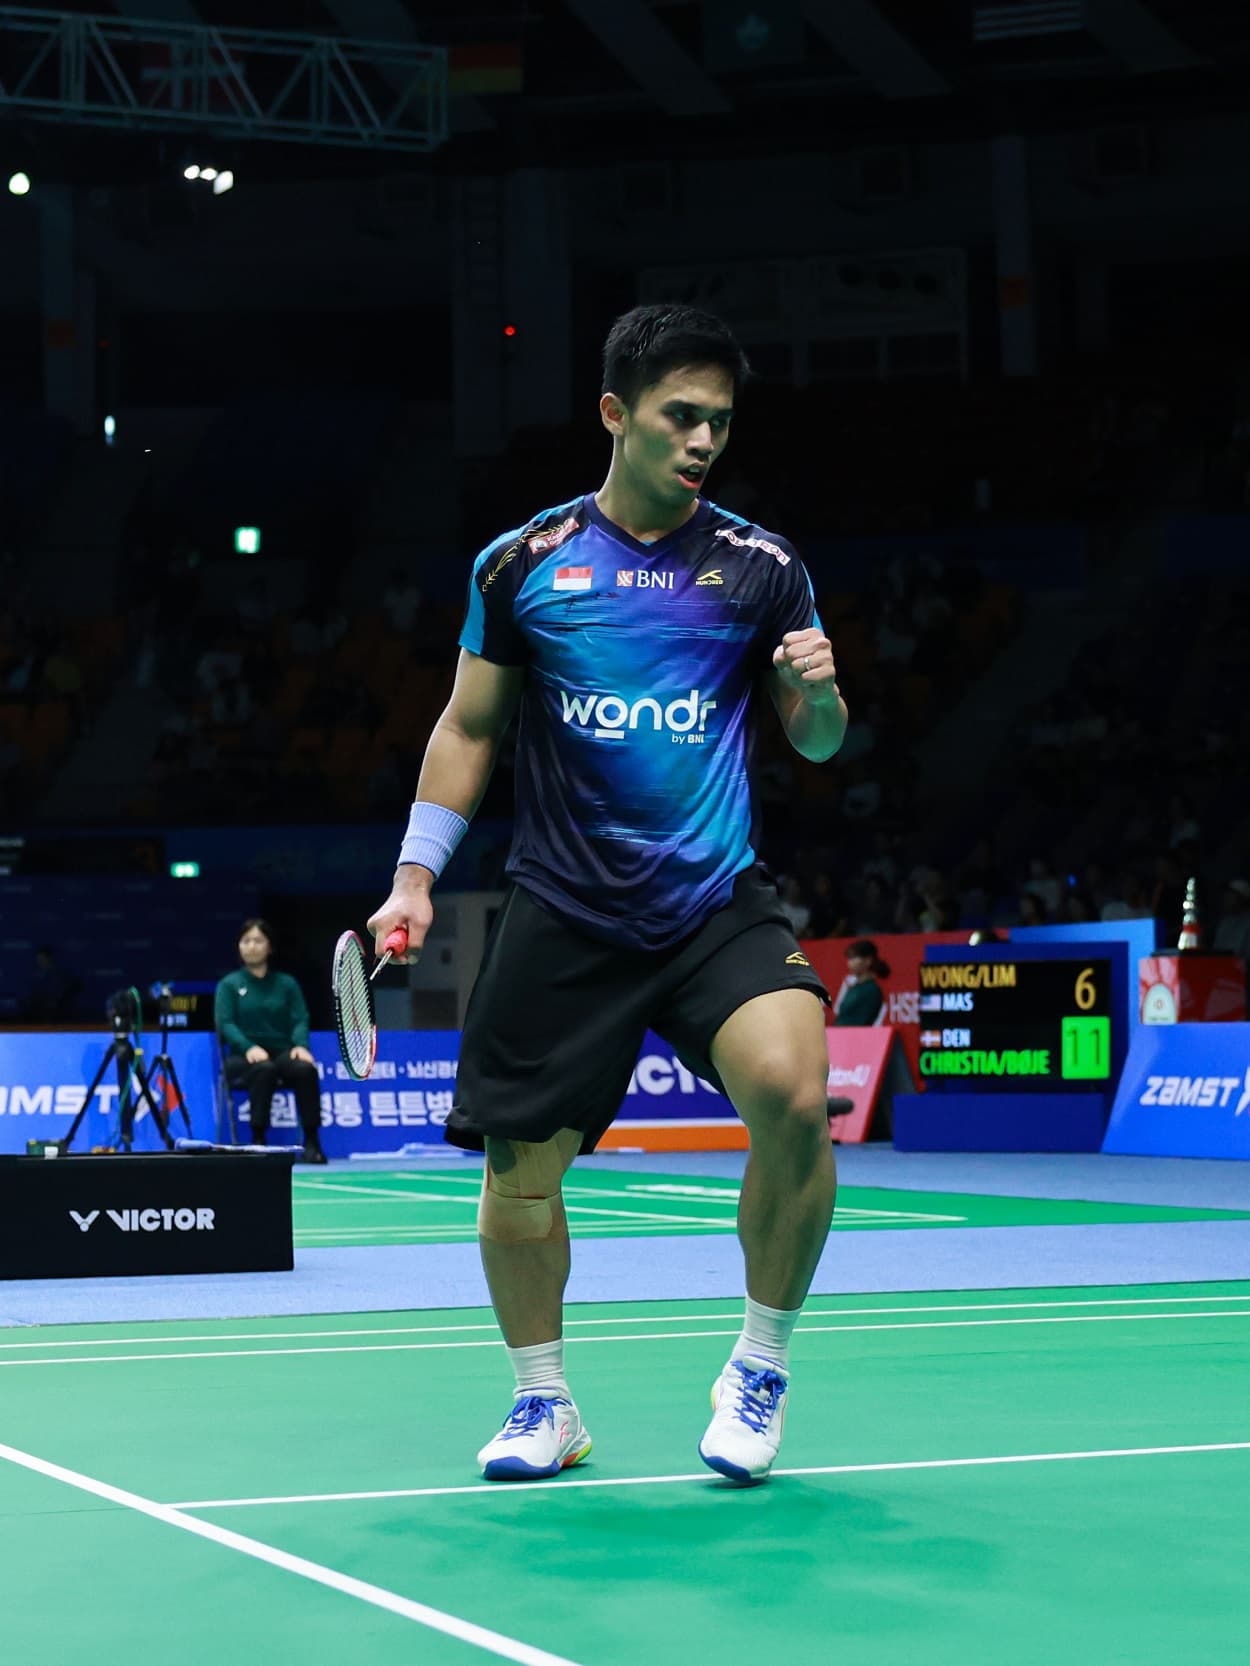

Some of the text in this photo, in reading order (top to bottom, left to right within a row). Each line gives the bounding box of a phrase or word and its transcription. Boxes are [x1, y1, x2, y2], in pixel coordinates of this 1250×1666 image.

[636, 569, 674, 590] BNI
[559, 689, 717, 737] wondr
[671, 733, 705, 745] by BNI
[920, 964, 1097, 1010] WONG/LIM 6
[942, 992, 974, 1011] MAS
[942, 1028, 971, 1047] DEN
[1067, 1028, 1101, 1067] 11
[106, 1208, 215, 1231] VICTOR
